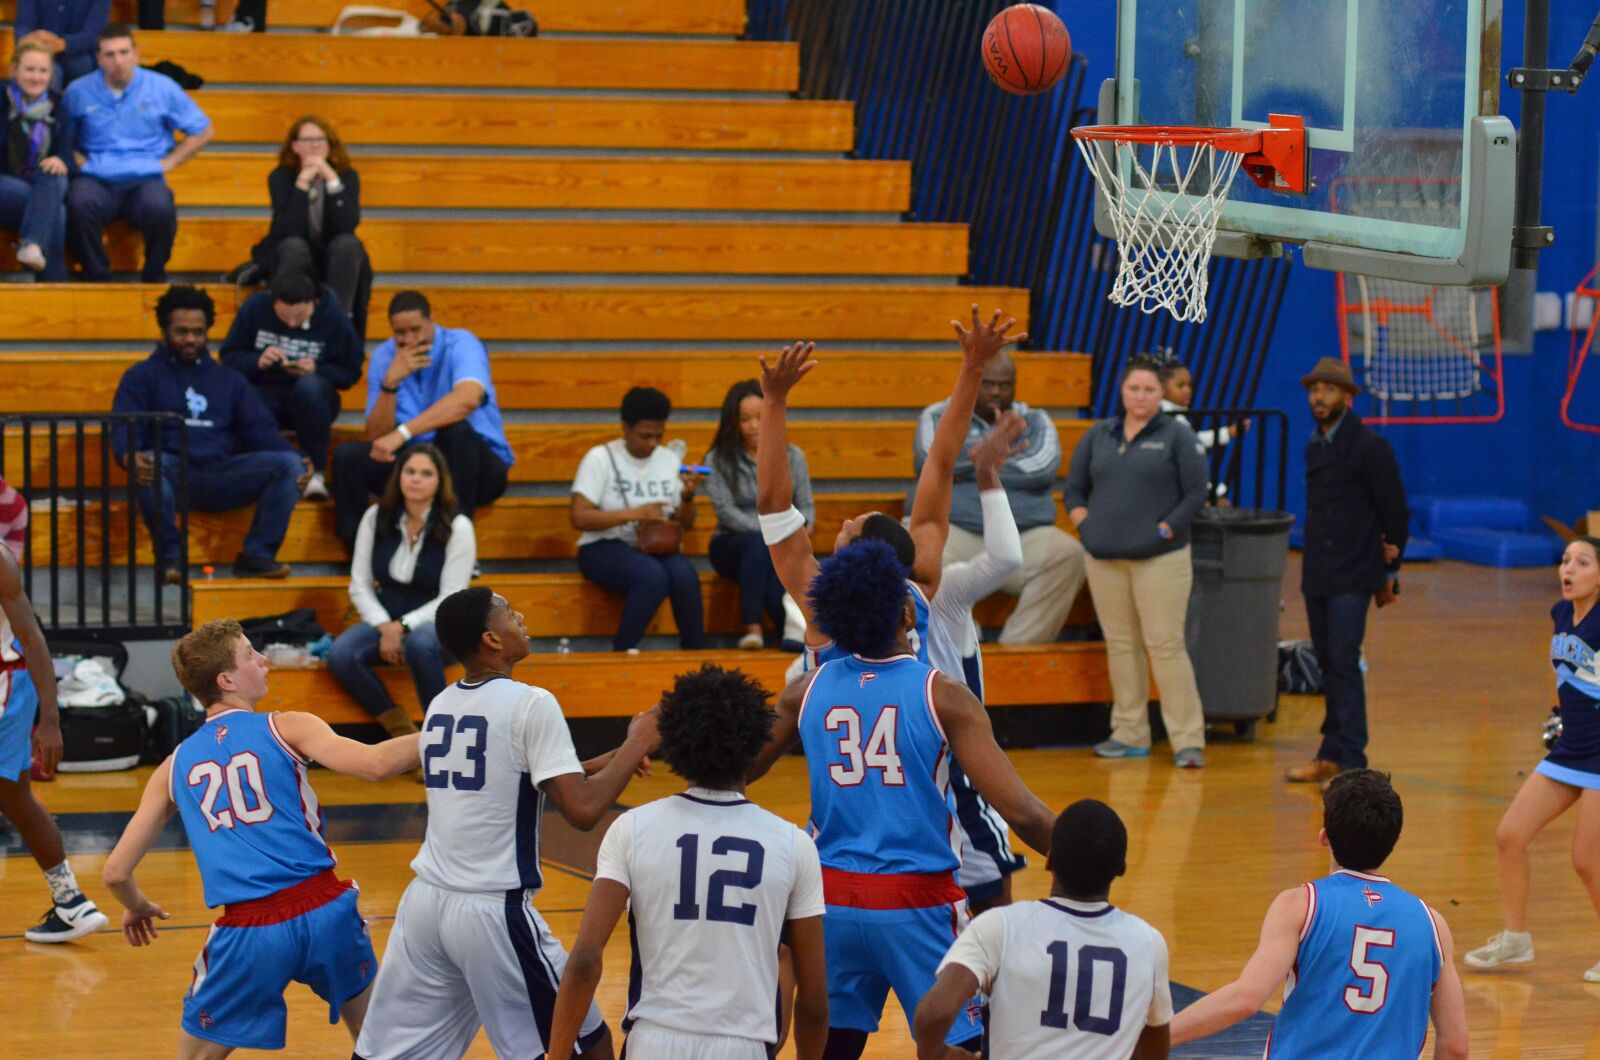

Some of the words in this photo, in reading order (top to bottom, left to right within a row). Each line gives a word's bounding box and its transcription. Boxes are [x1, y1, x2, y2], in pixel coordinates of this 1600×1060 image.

[613, 479, 673, 498] PACE
[424, 713, 488, 791] 23
[824, 704, 906, 787] 34
[187, 750, 275, 833] 20
[674, 833, 765, 926] 12
[1040, 940, 1127, 1036] 10
[1342, 924, 1396, 1015] 5
